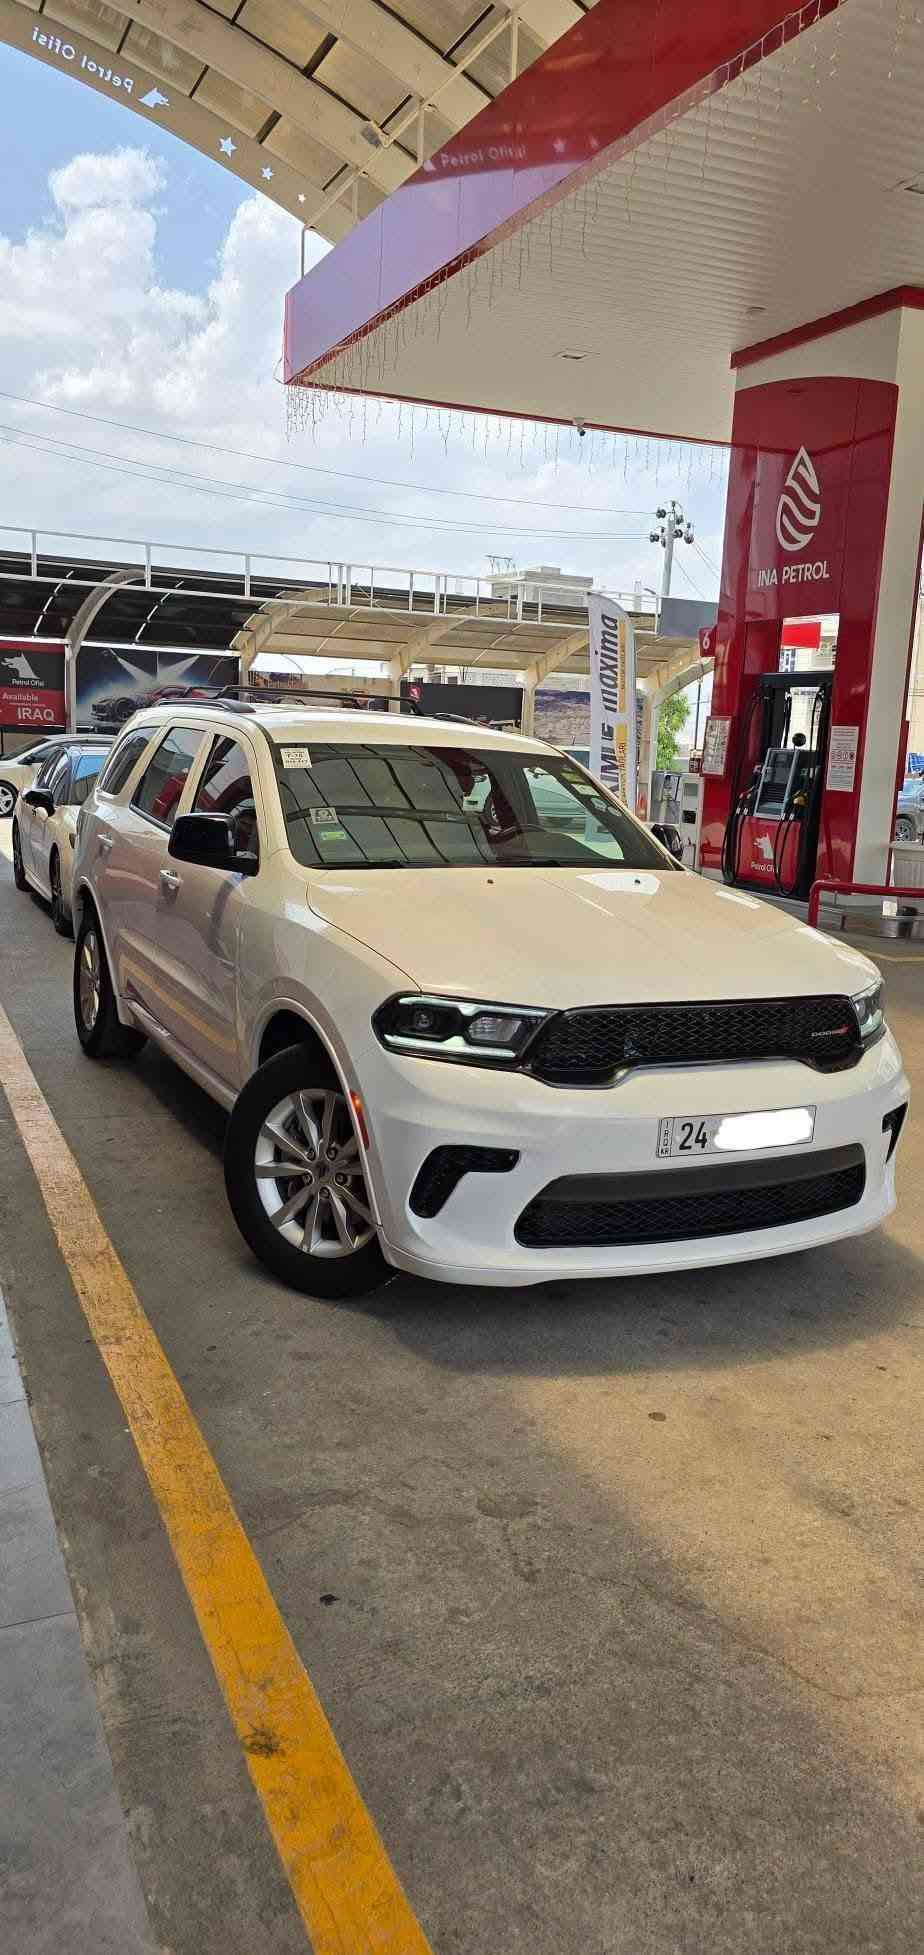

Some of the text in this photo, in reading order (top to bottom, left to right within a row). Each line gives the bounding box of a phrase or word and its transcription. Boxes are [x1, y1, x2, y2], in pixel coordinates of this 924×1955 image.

[757, 560, 830, 588] INA PETROL
[702, 631, 710, 650] 6
[595, 614, 618, 713] maxima
[2, 692, 39, 703] Available
[17, 707, 55, 722] IRAQ
[679, 1121, 707, 1150] 24
